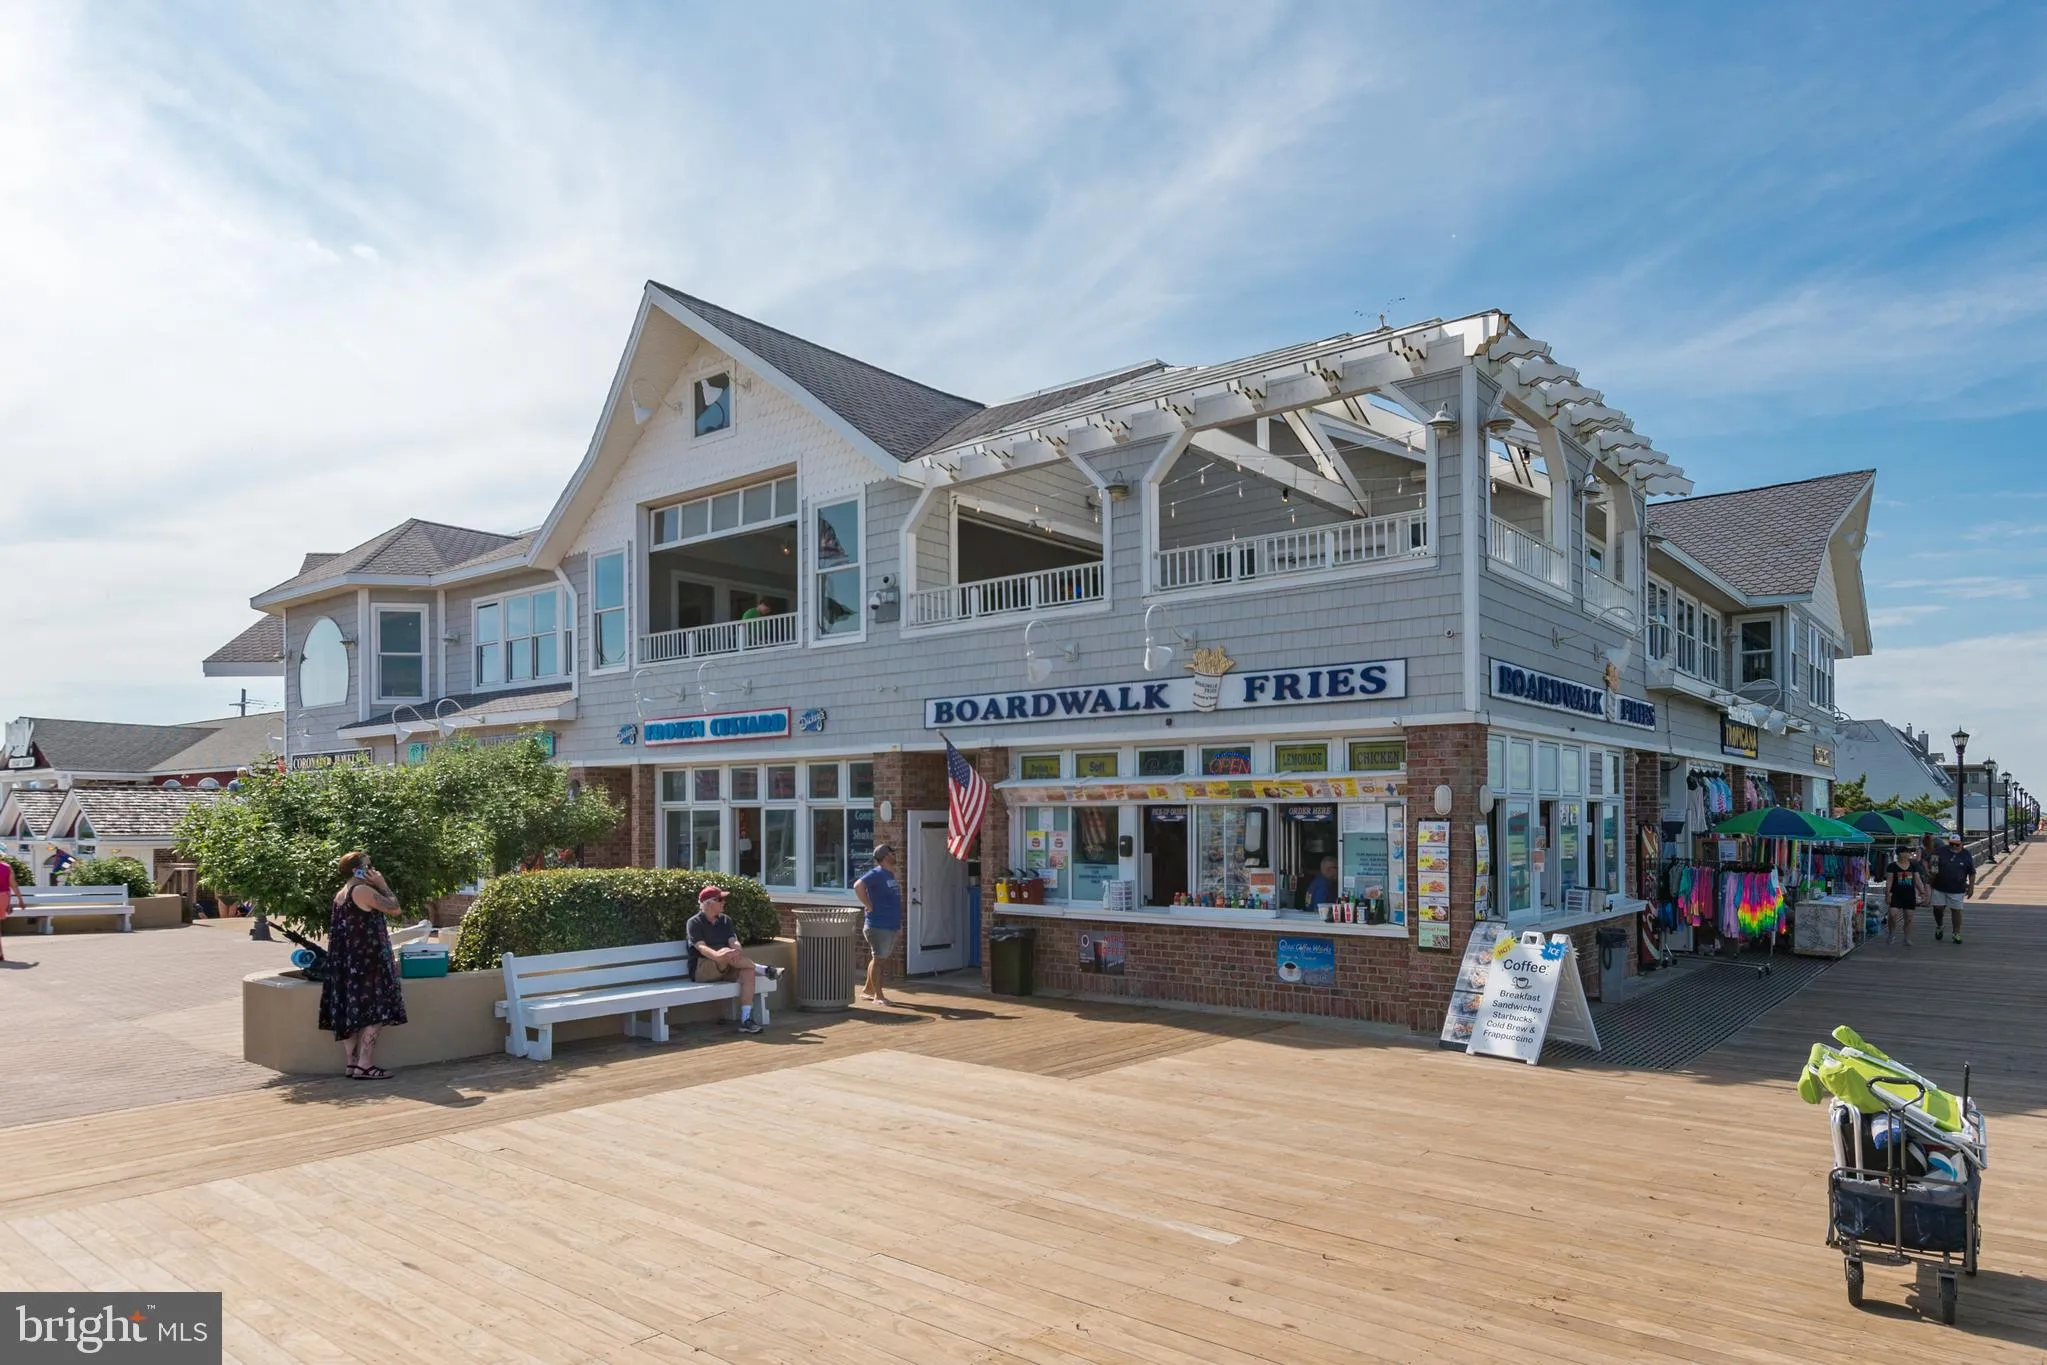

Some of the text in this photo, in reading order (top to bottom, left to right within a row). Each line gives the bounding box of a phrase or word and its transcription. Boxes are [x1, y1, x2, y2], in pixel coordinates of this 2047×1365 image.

[933, 665, 1388, 724] BOARDWALK FRIES
[1499, 665, 1655, 726] BOARDWALK FRIES
[644, 713, 787, 741] FROZEN CUSTARD
[1283, 752, 1322, 766] LEMONADE
[1357, 750, 1400, 765] CHICKEN
[1209, 757, 1250, 775] OPEN
[1288, 806, 1332, 815] ORDER HERE
[1497, 943, 1511, 957] HOT
[1548, 946, 1560, 957] ICE
[1503, 958, 1547, 974] Coffee
[1500, 989, 1541, 1002] Breakfast
[1492, 999, 1543, 1014] Sandwiches
[1486, 1019, 1536, 1034] Cold Brew &
[1483, 1028, 1534, 1044] Frappuccino
